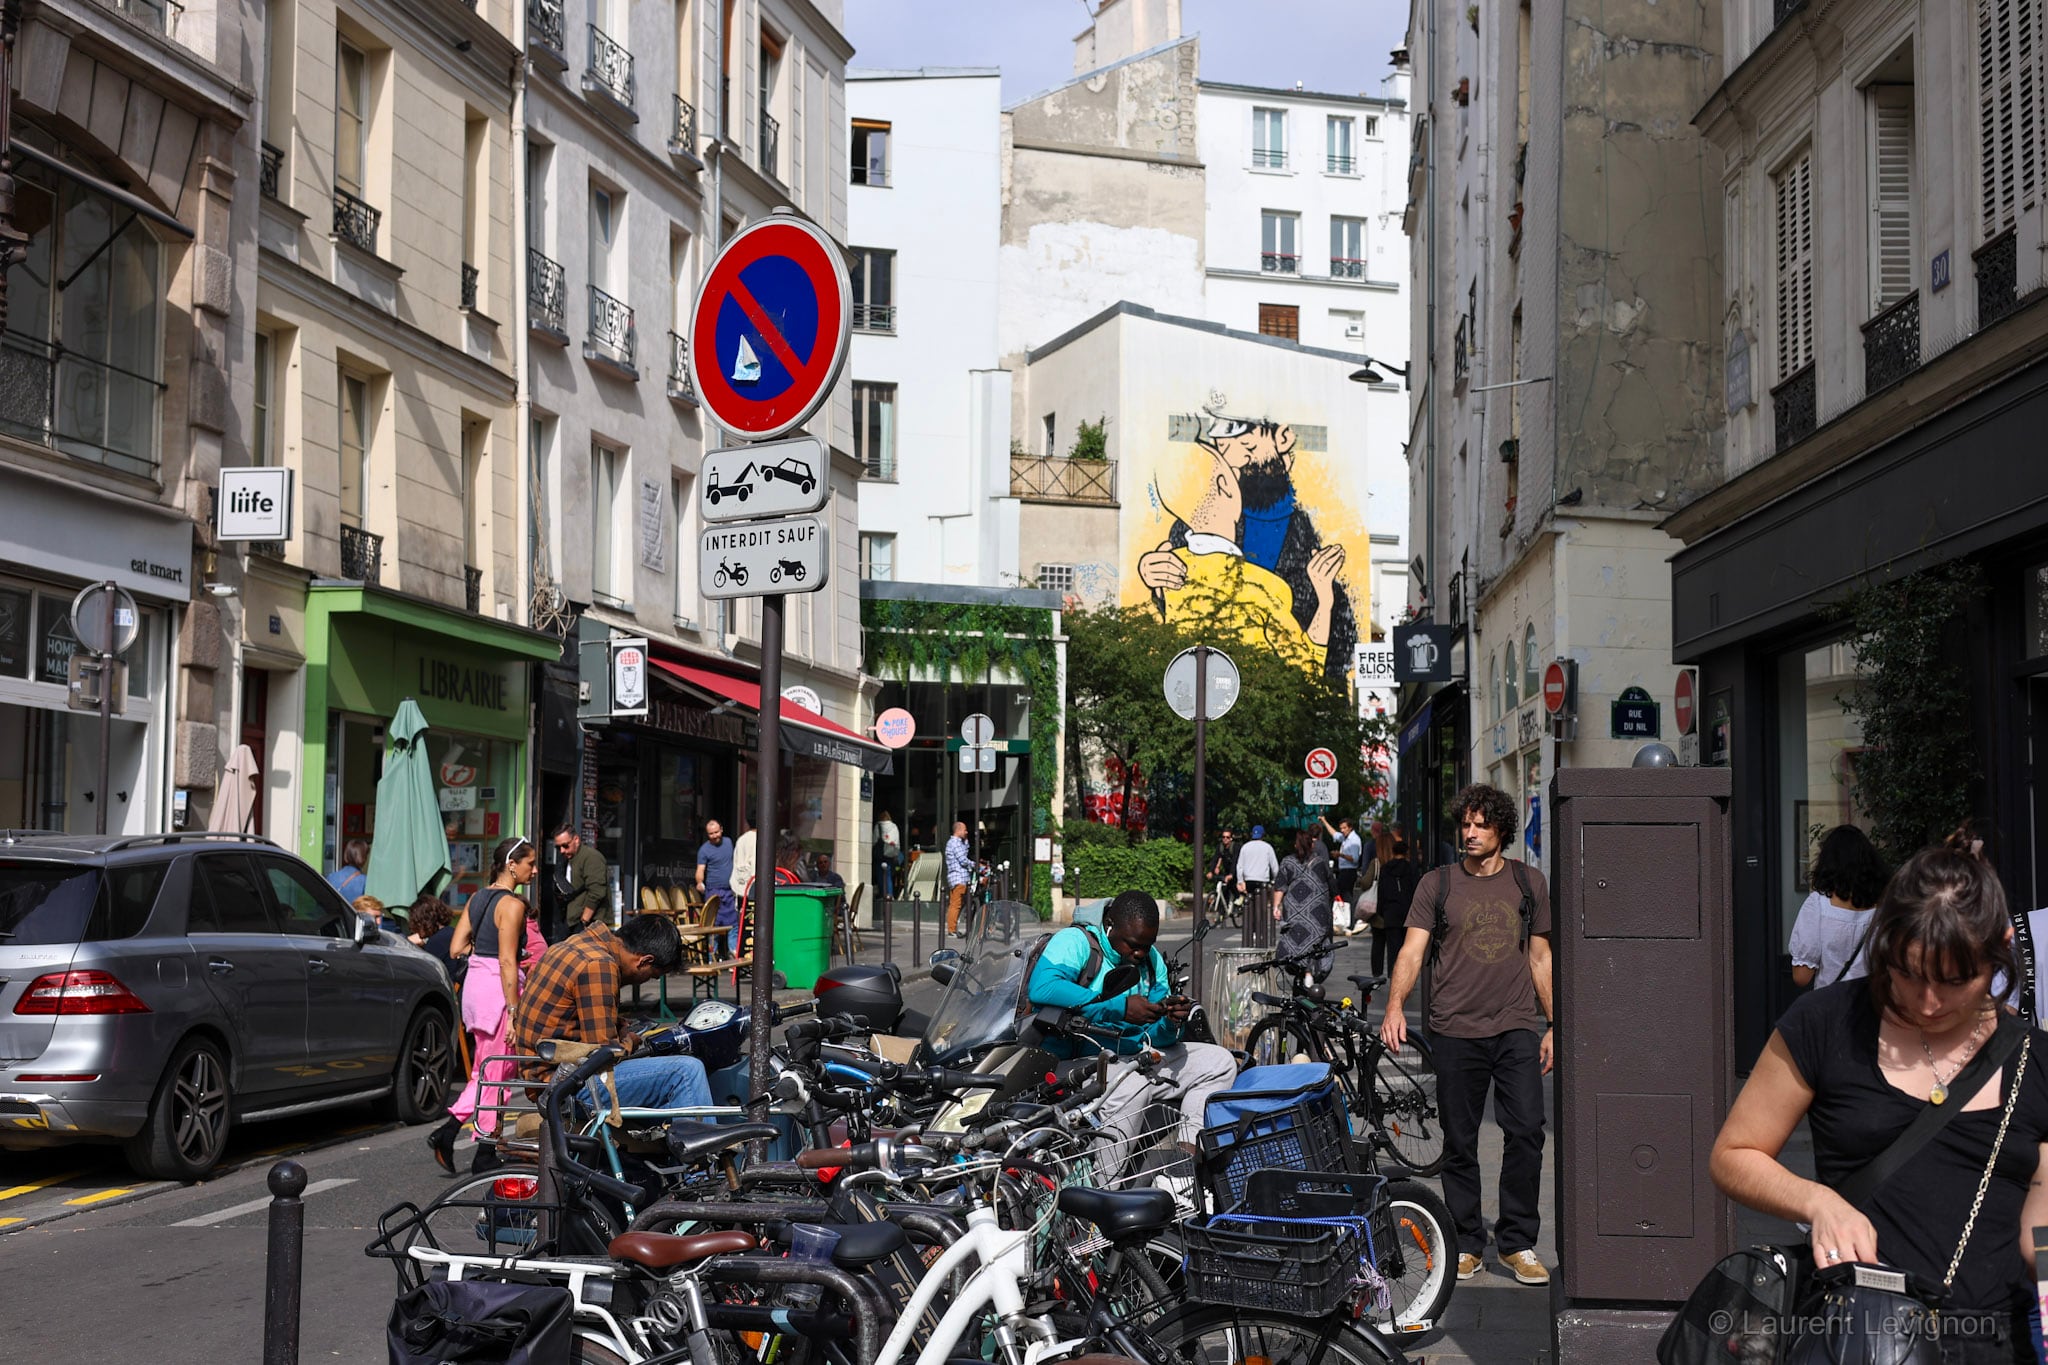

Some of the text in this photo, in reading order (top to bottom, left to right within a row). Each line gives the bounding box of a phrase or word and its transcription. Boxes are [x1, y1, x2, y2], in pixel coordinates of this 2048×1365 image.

[1933, 256, 1947, 286] 30
[231, 487, 273, 513] liife
[706, 526, 815, 551] INTERDIT SAUF
[131, 558, 182, 583] eat smart
[1359, 652, 1394, 662] FRED
[419, 657, 508, 711] LIBRAIRIE
[1628, 709, 1643, 719] RUE
[1623, 722, 1648, 732] DU NIL
[814, 742, 822, 755] LE
[2022, 947, 2035, 990] JIMMY
